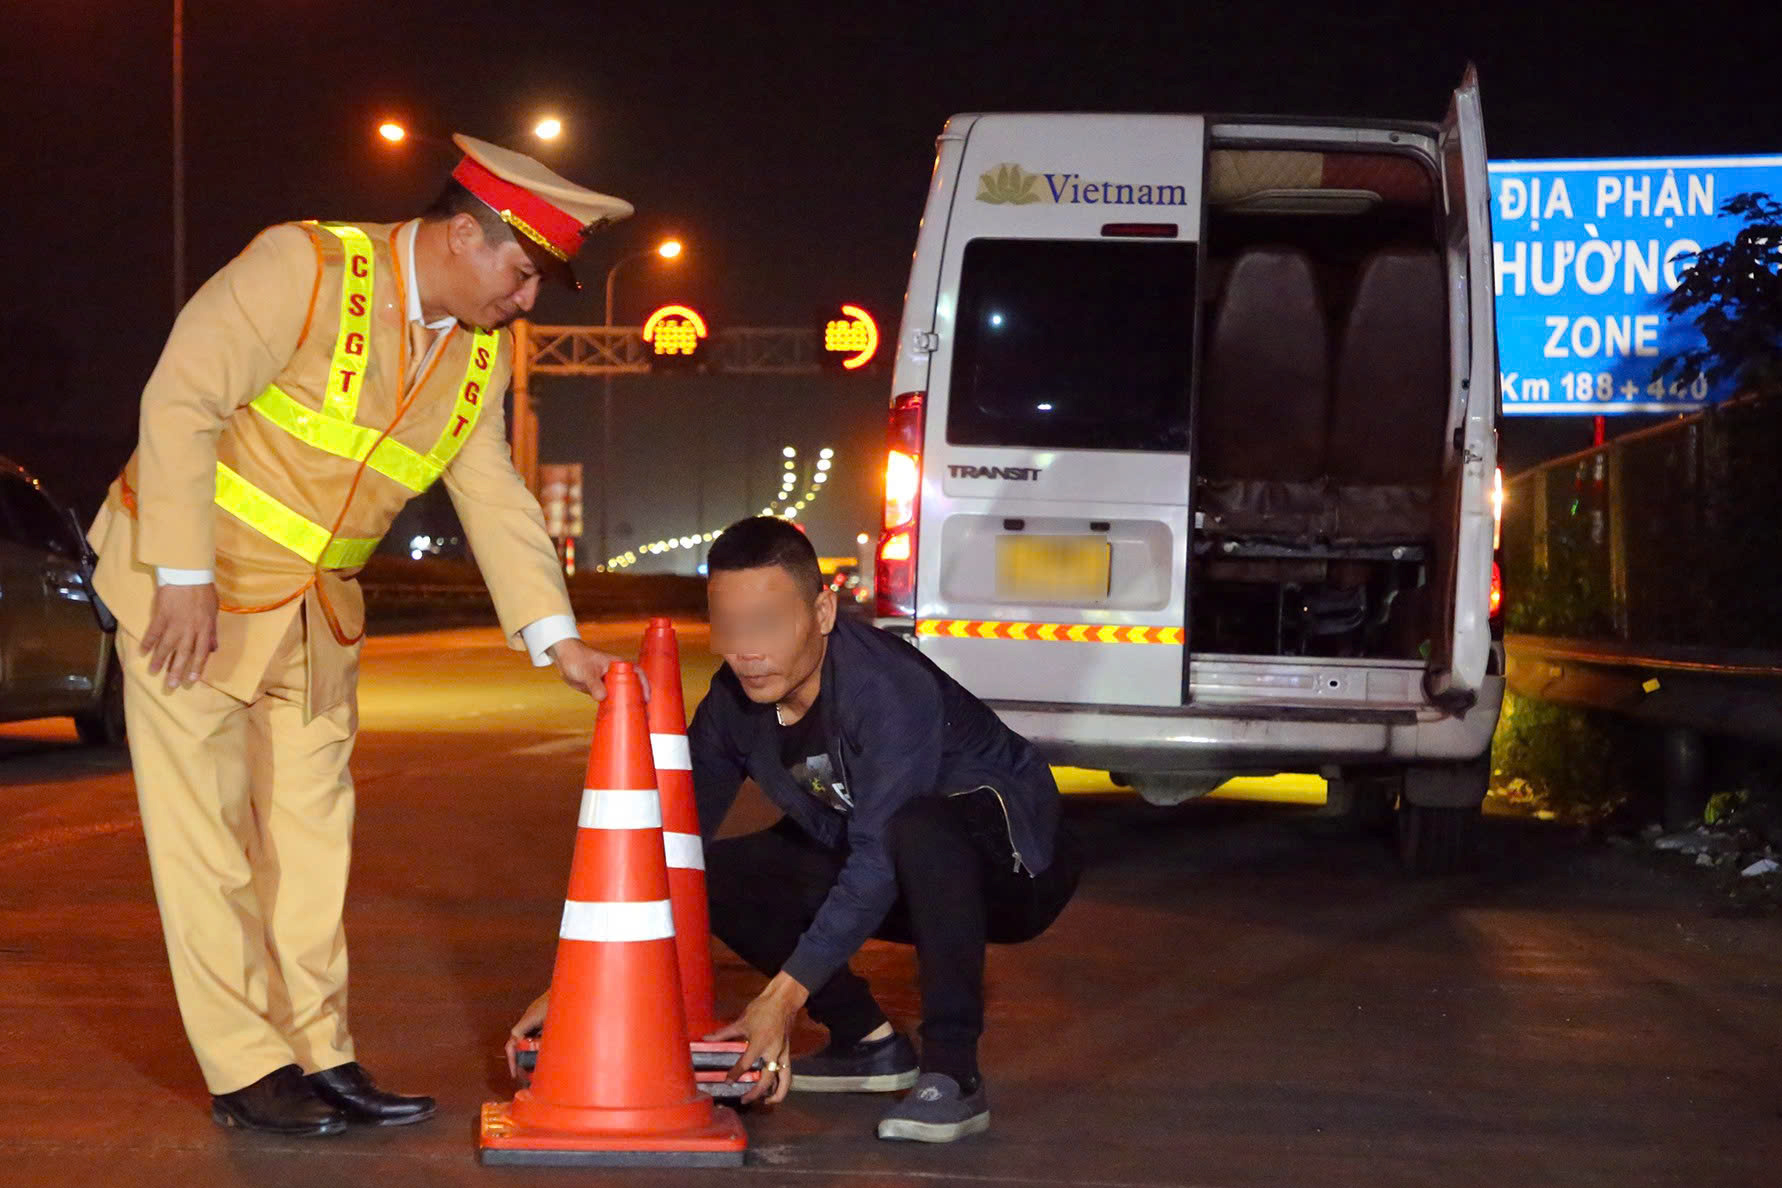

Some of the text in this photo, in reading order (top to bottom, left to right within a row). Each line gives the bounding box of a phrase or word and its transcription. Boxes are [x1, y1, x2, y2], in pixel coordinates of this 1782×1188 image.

[1043, 173, 1188, 206] Vietnam
[1498, 168, 1715, 232] ĐỊA PHẬN
[1543, 315, 1660, 358] ZONE
[452, 328, 494, 438] SGT
[1500, 371, 1550, 401] Km
[1560, 371, 1614, 402] 188
[947, 465, 1043, 481] TRANSIT
